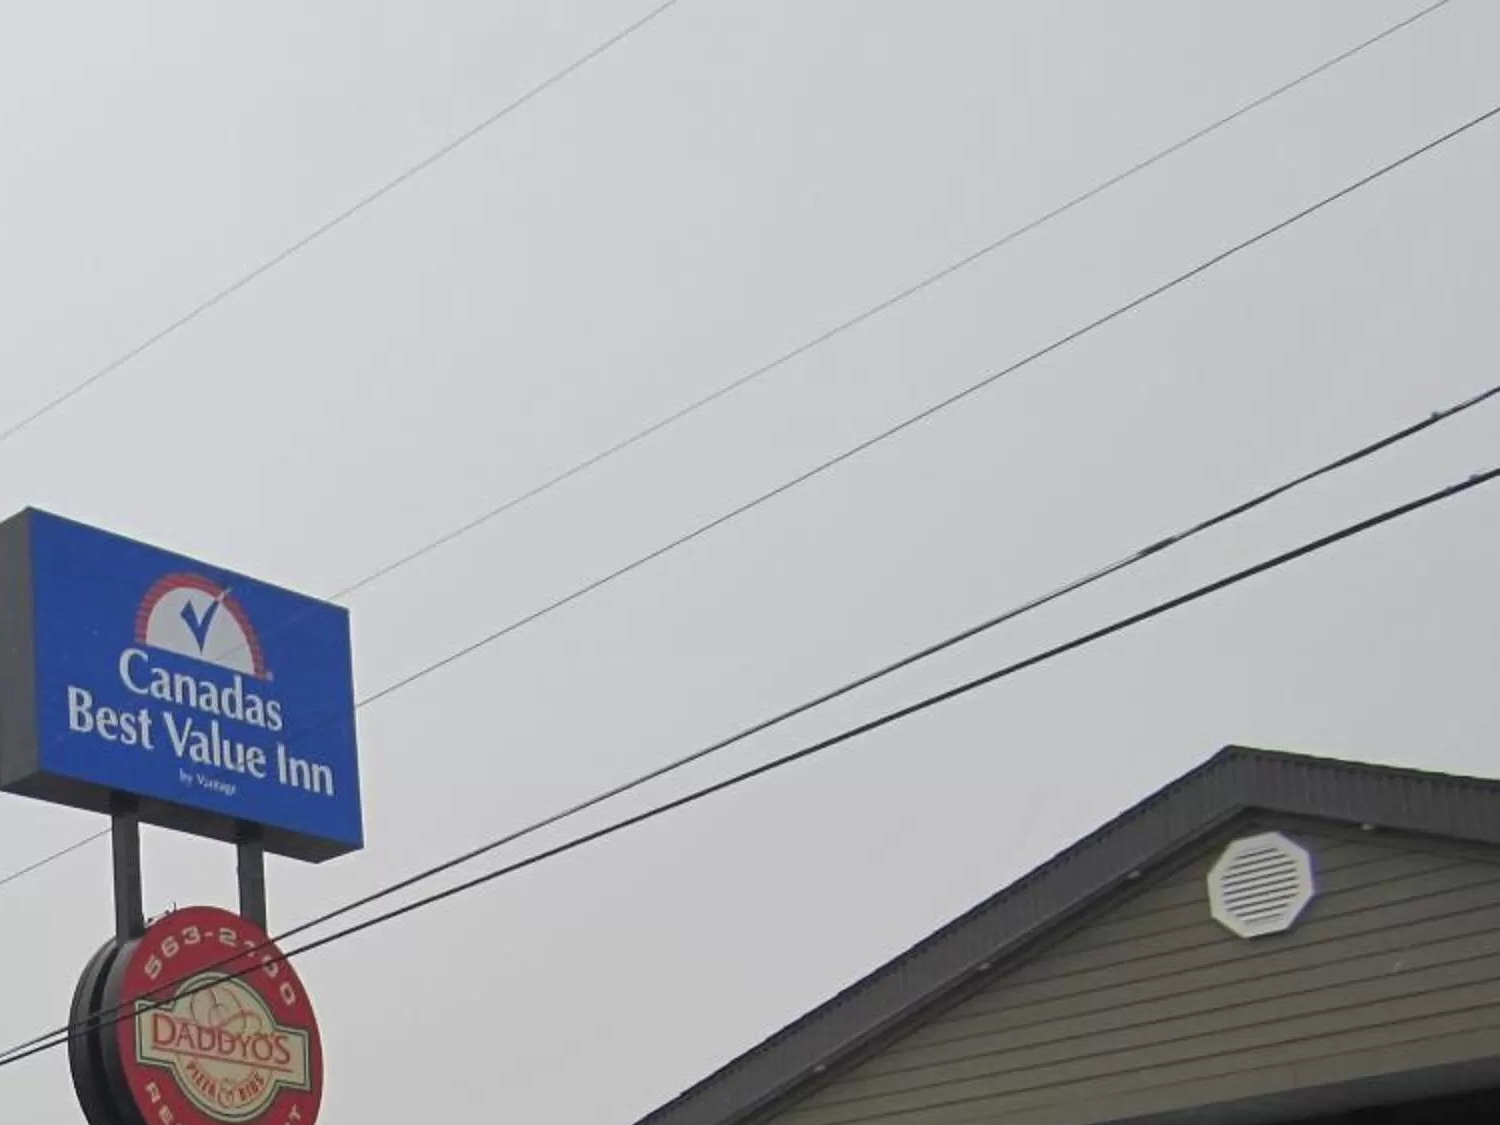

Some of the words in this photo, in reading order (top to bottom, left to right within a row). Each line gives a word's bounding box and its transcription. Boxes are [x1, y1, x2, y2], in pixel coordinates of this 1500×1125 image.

[119, 648, 284, 731] Canadas
[67, 684, 155, 750] Best
[162, 711, 267, 780] Value
[276, 742, 335, 797] Inn
